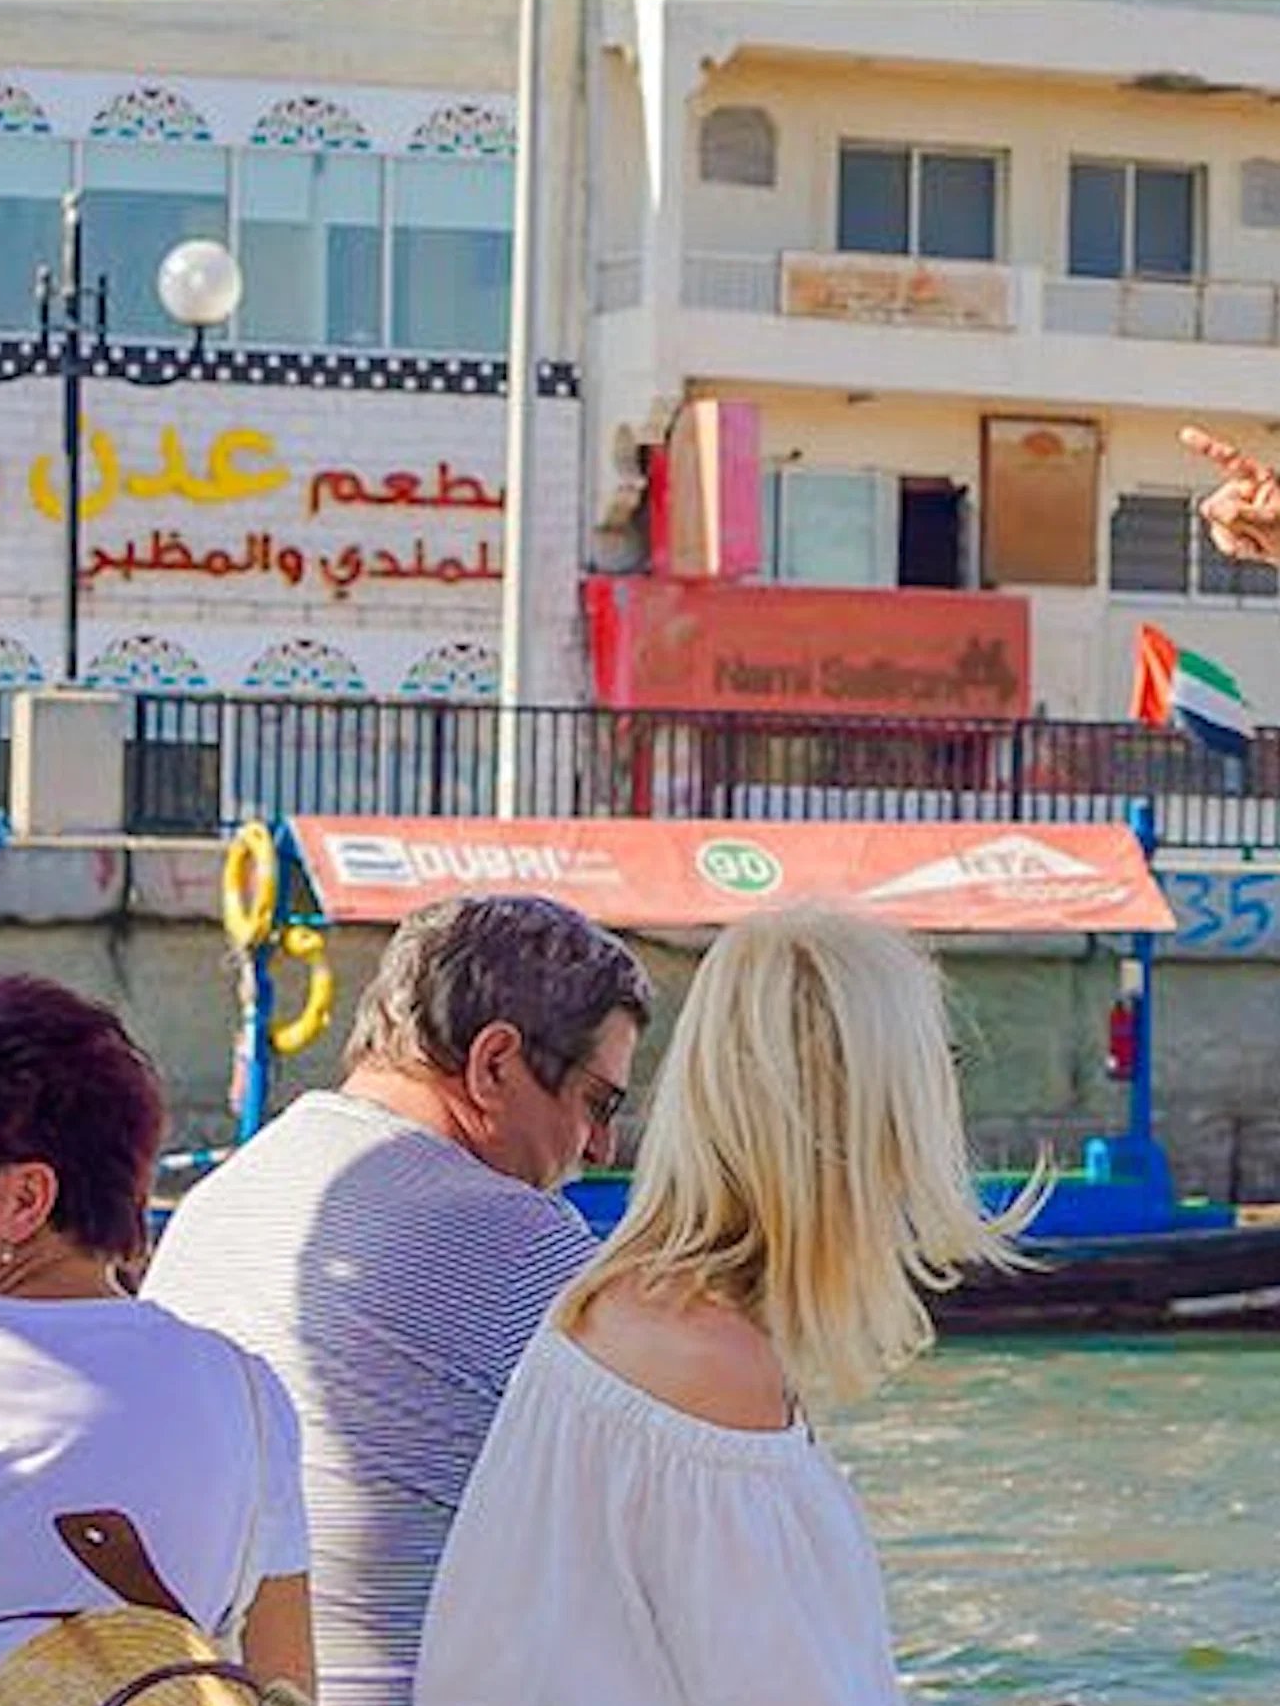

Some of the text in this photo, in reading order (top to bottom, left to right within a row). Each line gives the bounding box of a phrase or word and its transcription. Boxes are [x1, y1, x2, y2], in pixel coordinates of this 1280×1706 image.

[27, 405, 505, 522] طعم عدن
[319, 538, 505, 600] لمندي
[707, 849, 771, 884] 90
[1173, 872, 1276, 949] 35
